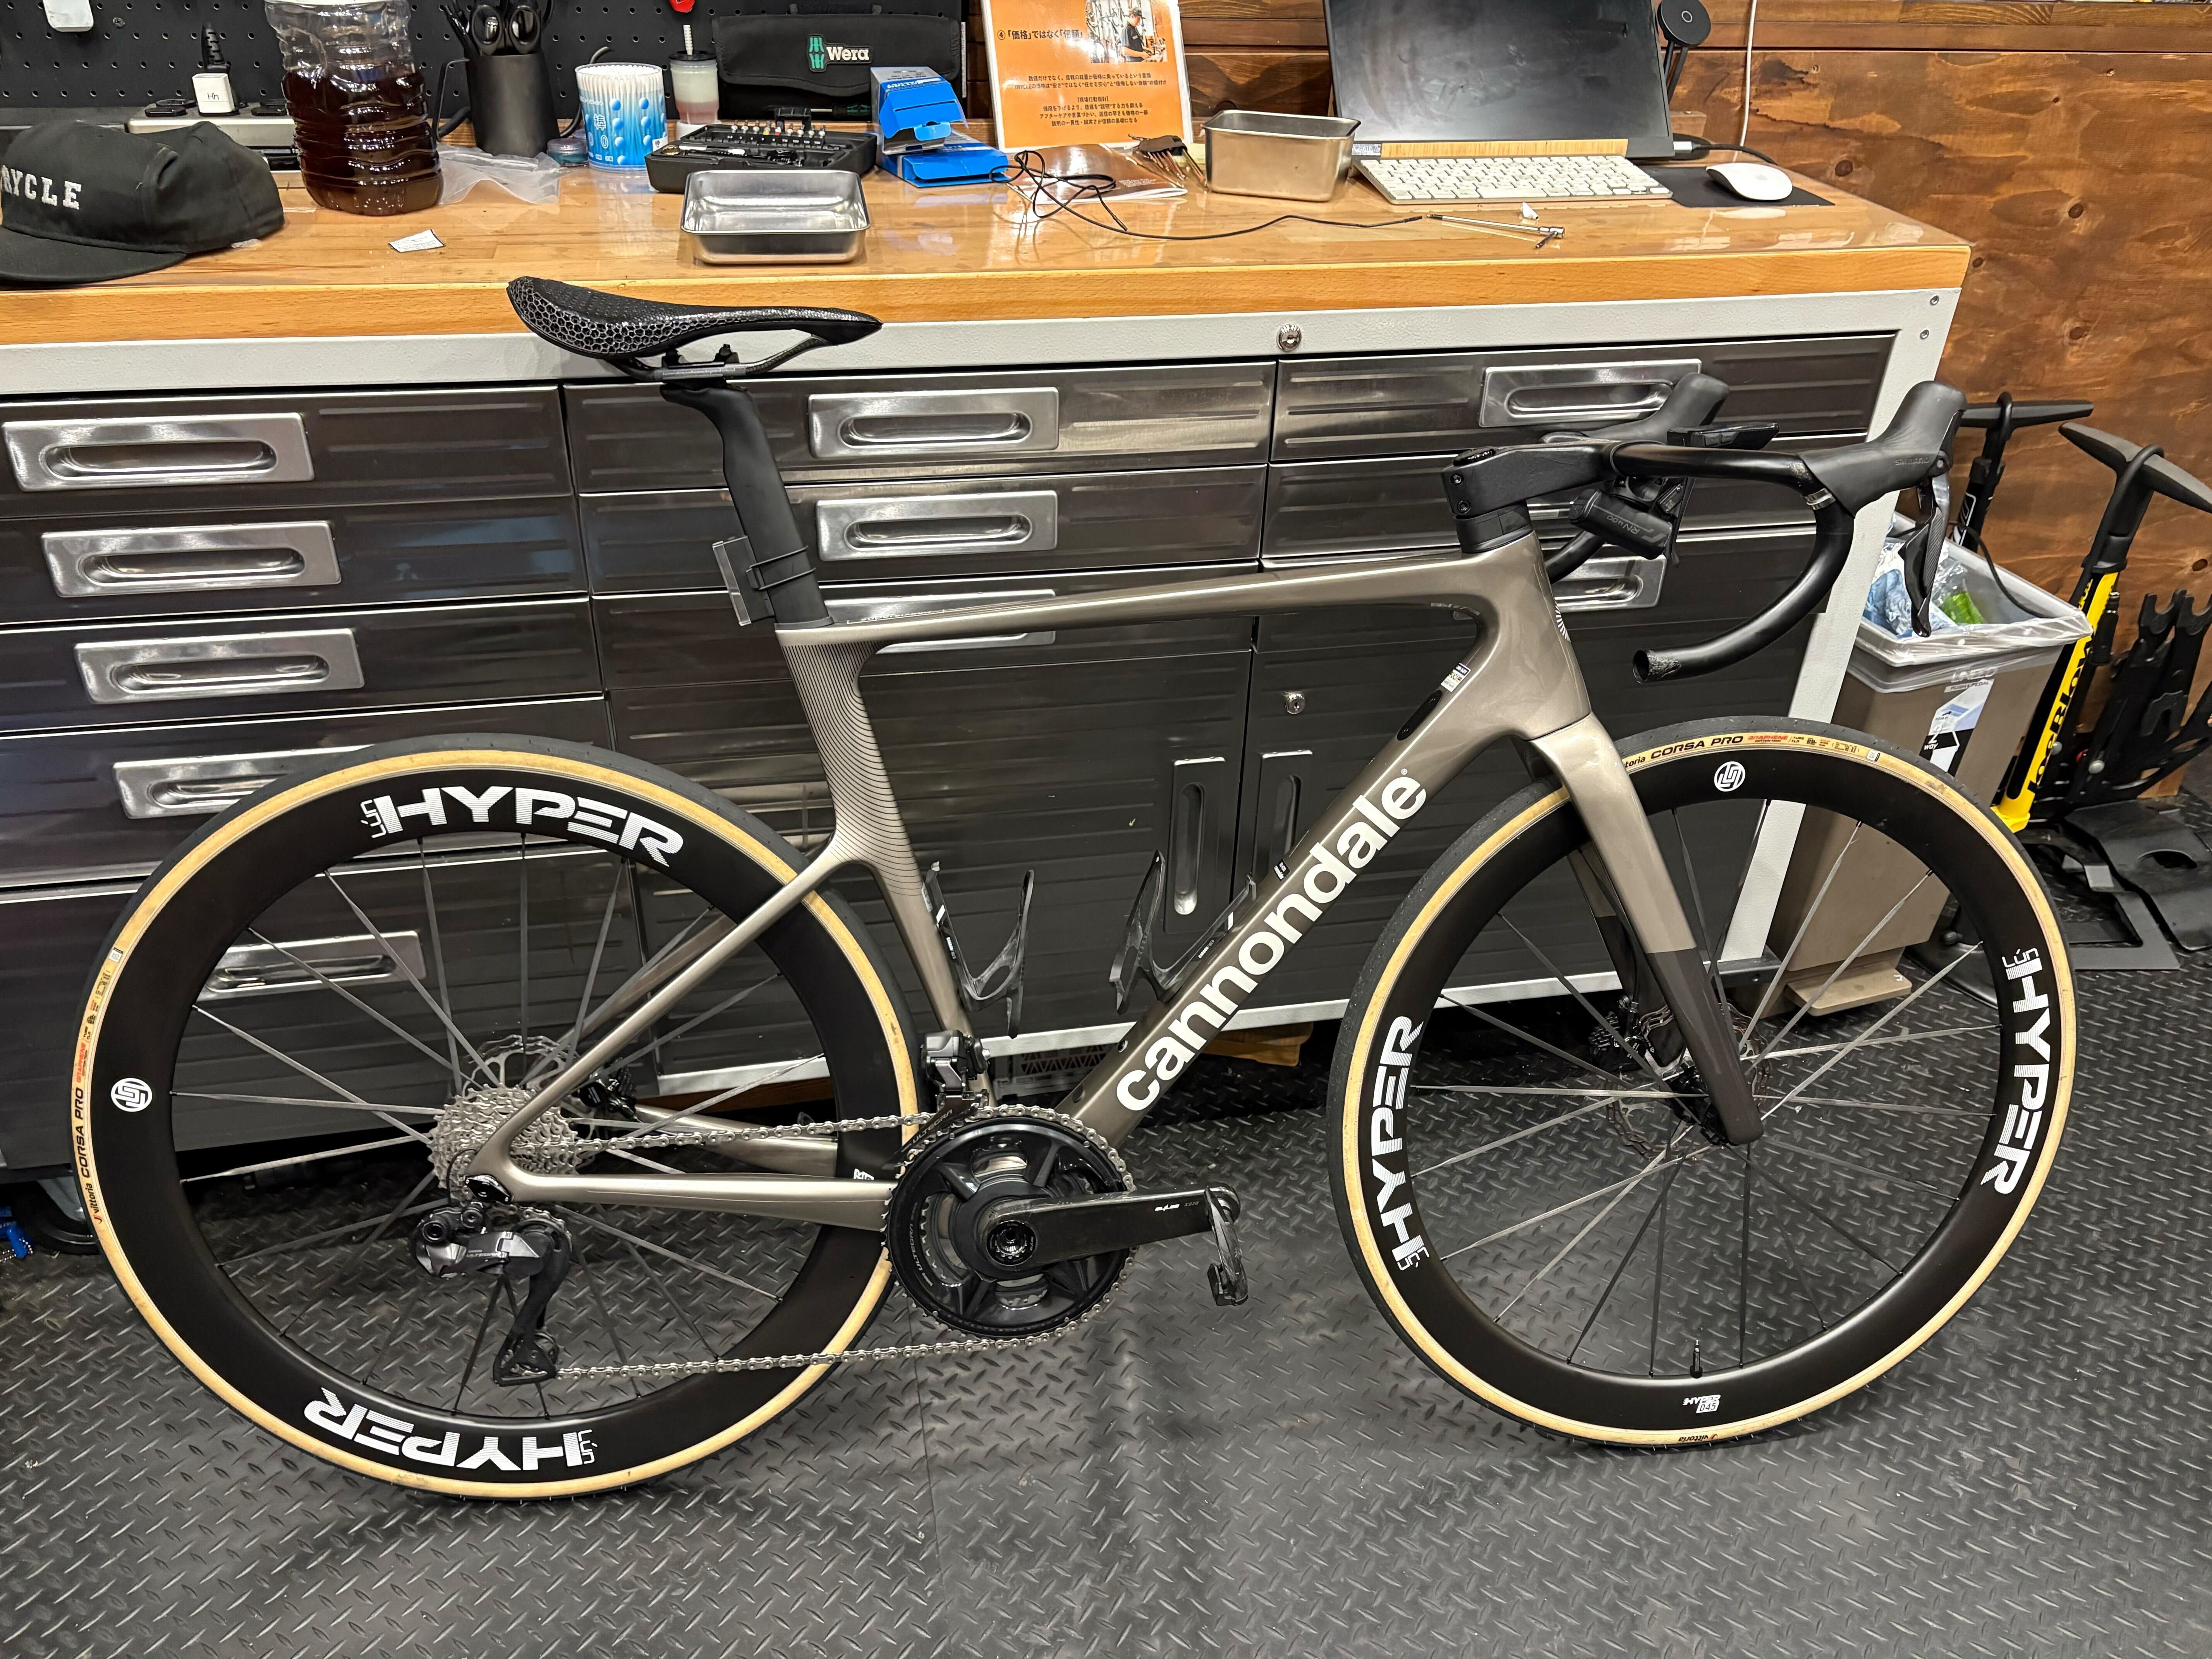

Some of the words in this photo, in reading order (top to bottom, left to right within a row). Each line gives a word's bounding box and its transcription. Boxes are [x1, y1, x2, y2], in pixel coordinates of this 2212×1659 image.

[826, 46, 869, 61] Wera
[1, 165, 81, 210] RYCLE
[1625, 756, 1646, 768] toria
[1651, 740, 1705, 759] CORSA
[1711, 736, 1743, 746] PRO
[373, 786, 684, 867] HYPER
[1116, 776, 1427, 1111] cannondale
[1980, 957, 2051, 1194] HYPER
[74, 1087, 84, 1120] PRO
[912, 1109, 953, 1144] ULTEGRA
[1371, 1016, 1424, 1262] HYPER
[76, 1125, 91, 1178] CORSA
[86, 1183, 100, 1214] vittoria
[1685, 1394, 1721, 1405] HYPER
[304, 1387, 583, 1471] HYPER
[1678, 1434, 1709, 1443] vittoria
